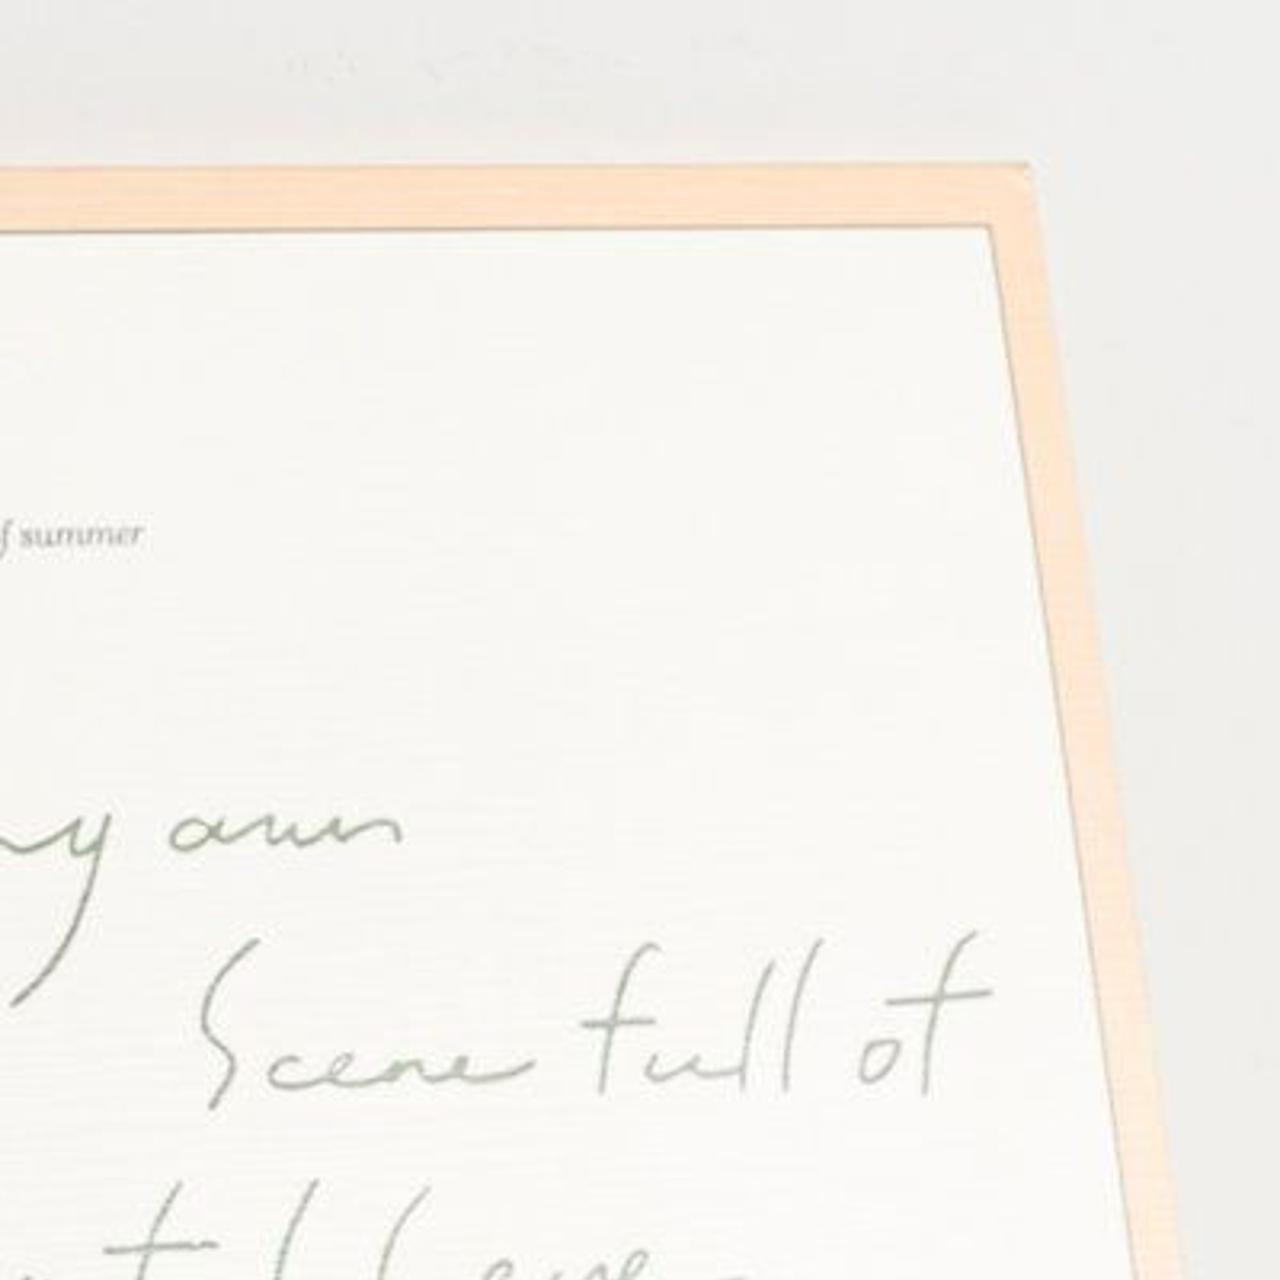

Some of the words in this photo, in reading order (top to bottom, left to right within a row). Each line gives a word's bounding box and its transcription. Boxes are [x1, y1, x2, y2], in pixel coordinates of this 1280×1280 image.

[19, 524, 146, 549] summer
[580, 938, 823, 1094] full
[858, 930, 993, 1095] of
